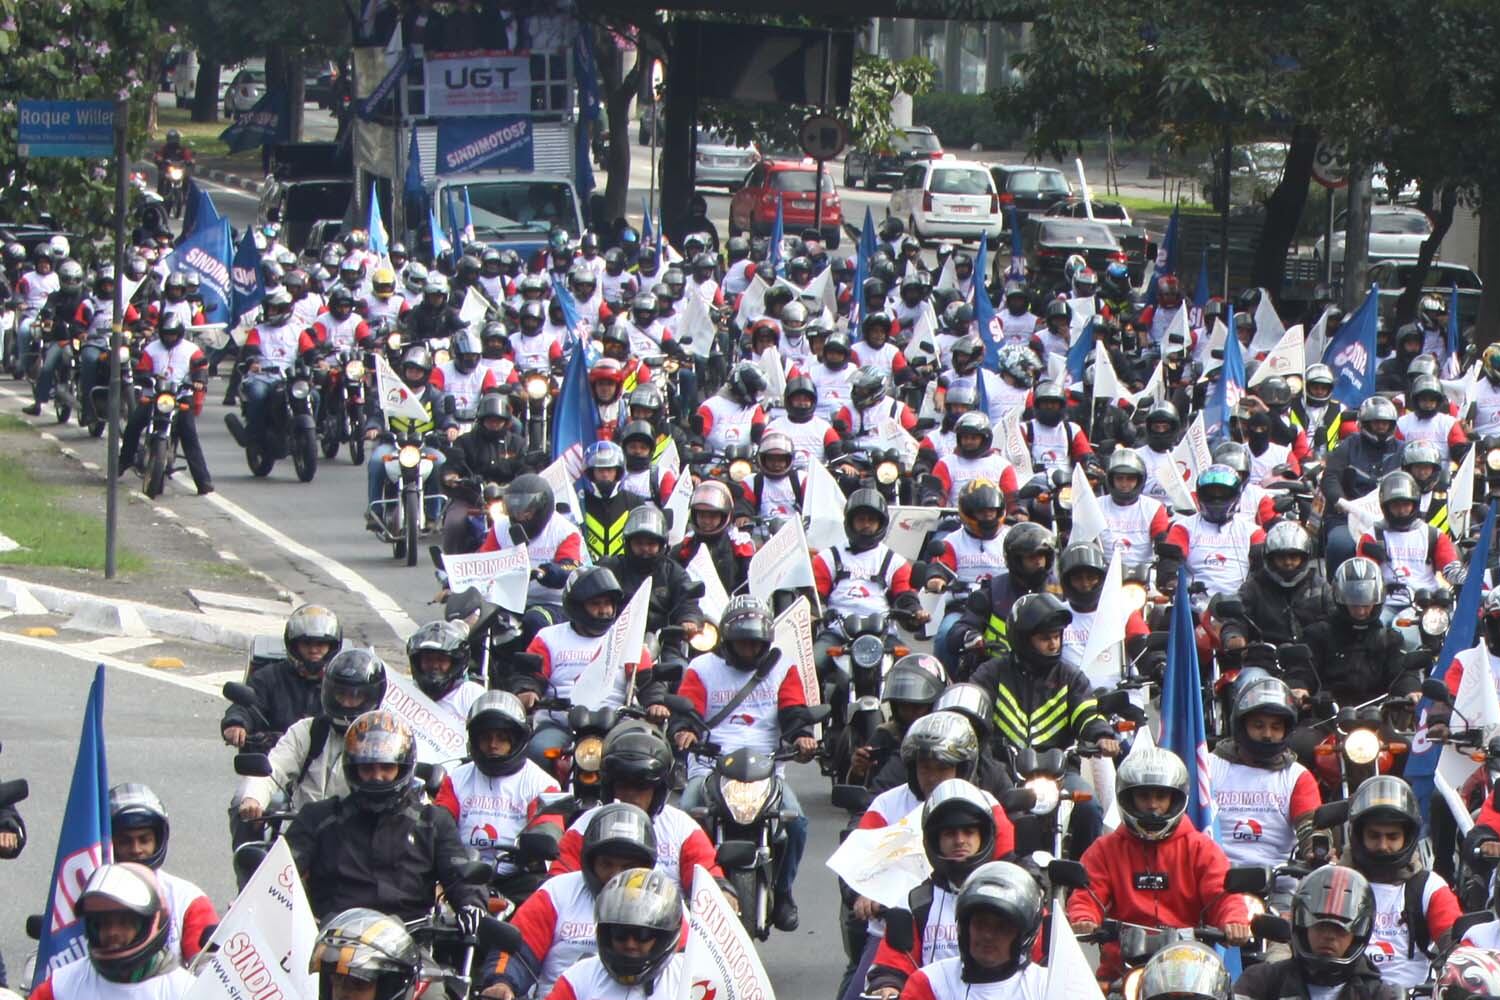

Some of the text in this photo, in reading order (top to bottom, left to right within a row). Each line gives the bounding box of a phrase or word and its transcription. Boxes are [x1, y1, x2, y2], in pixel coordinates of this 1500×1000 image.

[445, 67, 517, 89] UGT
[20, 108, 70, 127] Roque
[446, 120, 528, 168] SINDIMOTOSP
[1233, 831, 1261, 841] UGT
